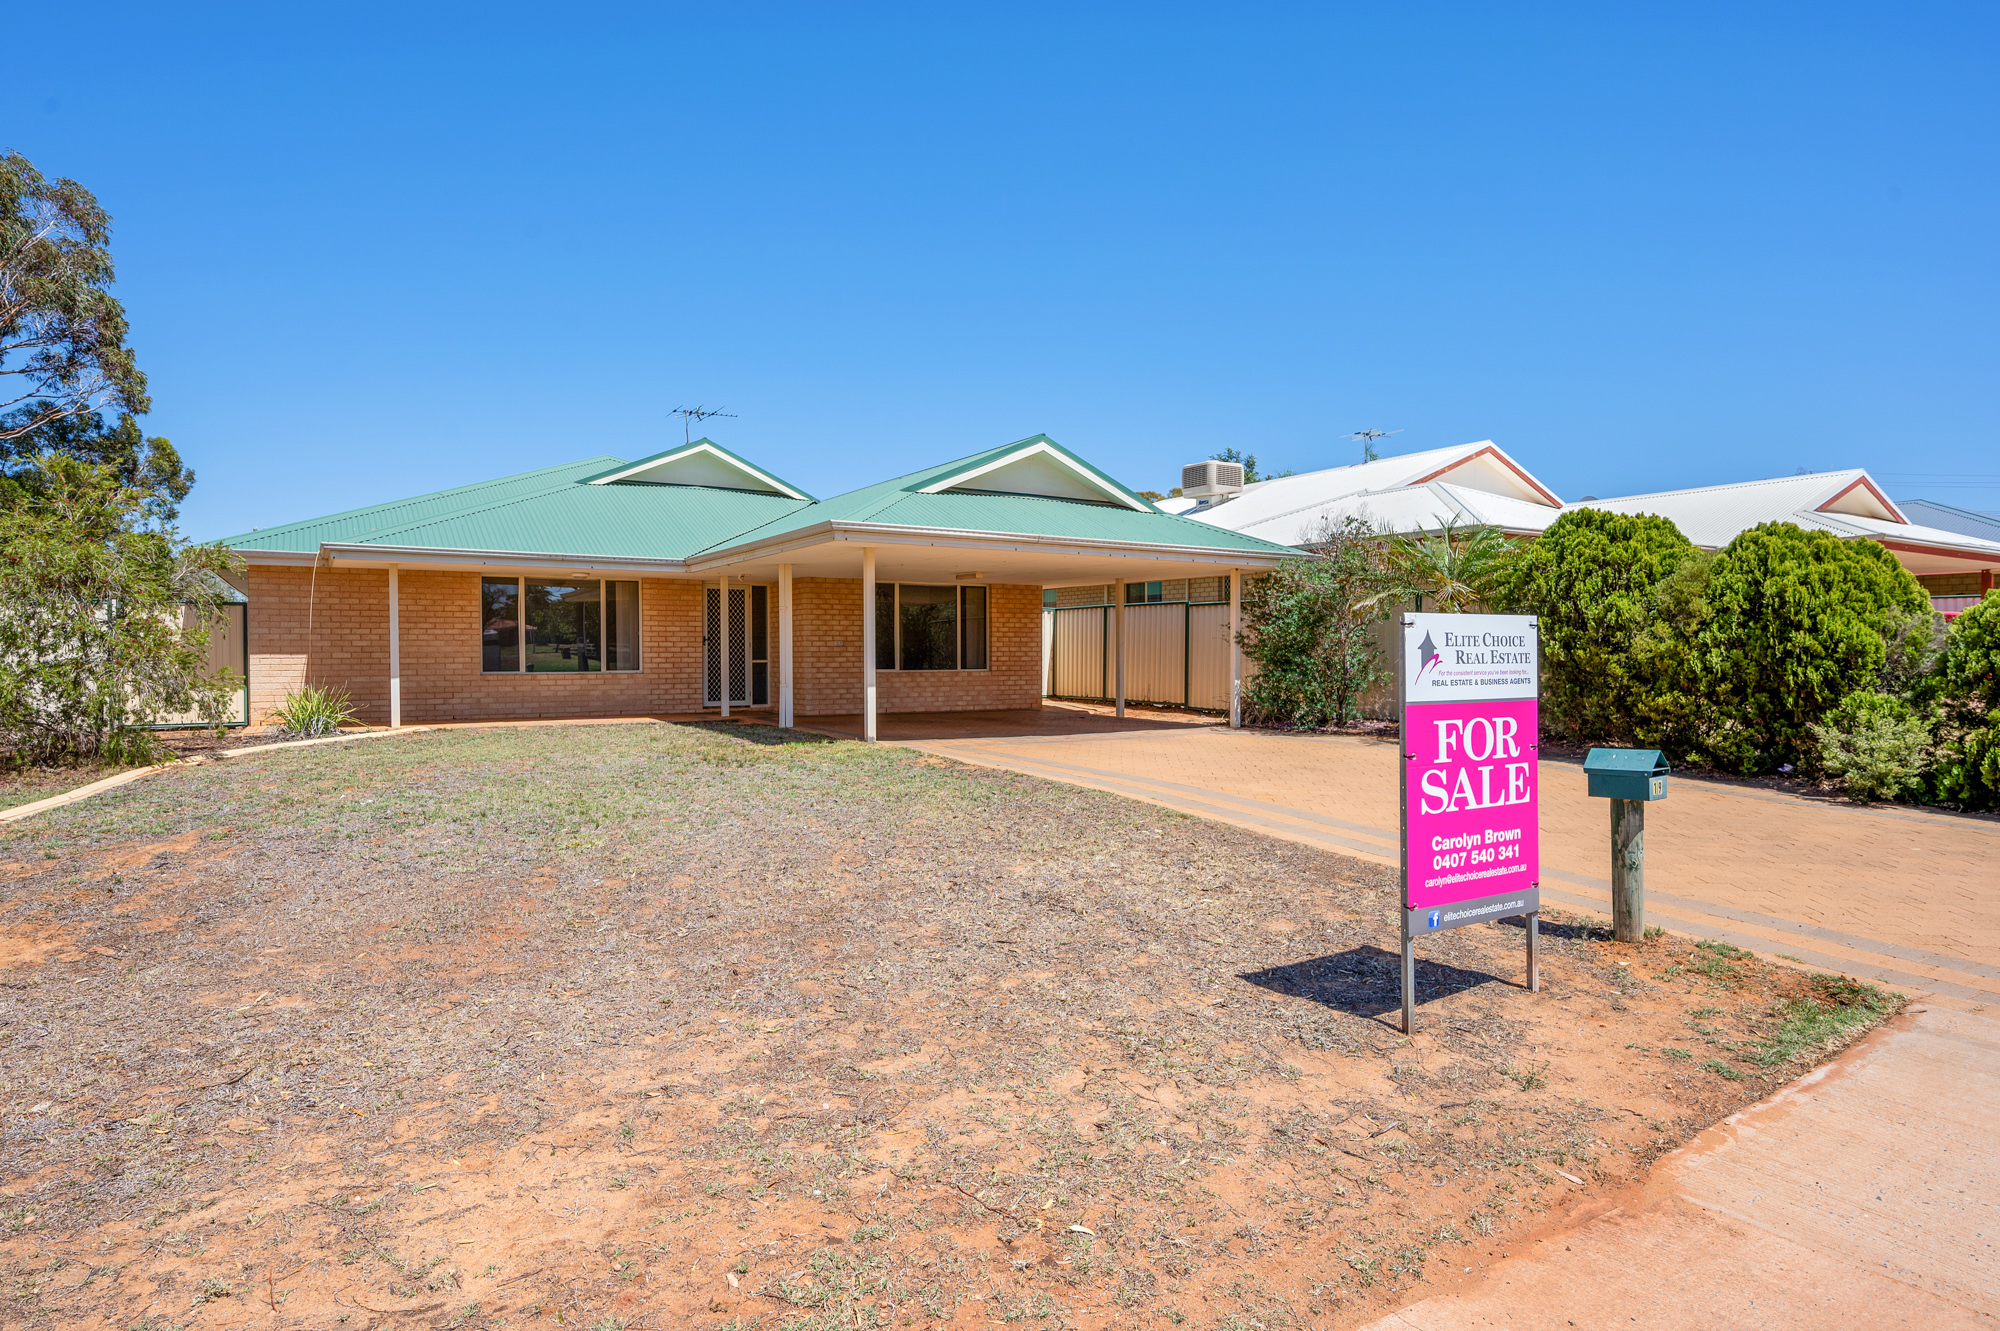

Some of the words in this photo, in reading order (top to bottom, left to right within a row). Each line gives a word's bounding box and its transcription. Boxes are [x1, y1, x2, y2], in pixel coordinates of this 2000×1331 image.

[1444, 632, 1480, 647] ELITE
[1482, 632, 1526, 647] CHOICE
[1455, 650, 1488, 665] REAL
[1490, 650, 1532, 664] ESTATE
[1480, 678, 1509, 686] BUSINESS
[1509, 677, 1531, 685] AGENTS
[1433, 717, 1520, 763] FOR
[1421, 762, 1530, 815] SALE
[1432, 833, 1481, 851] Carolyn
[1485, 828, 1521, 844] Brown
[1433, 852, 1467, 870] 0407
[1471, 848, 1495, 864] 540
[1498, 844, 1519, 860] 341
[1425, 863, 1527, 888] carolyn@elitechoicerealestate.com.au
[1443, 899, 1525, 922] elitechoicerealestate.com.au
